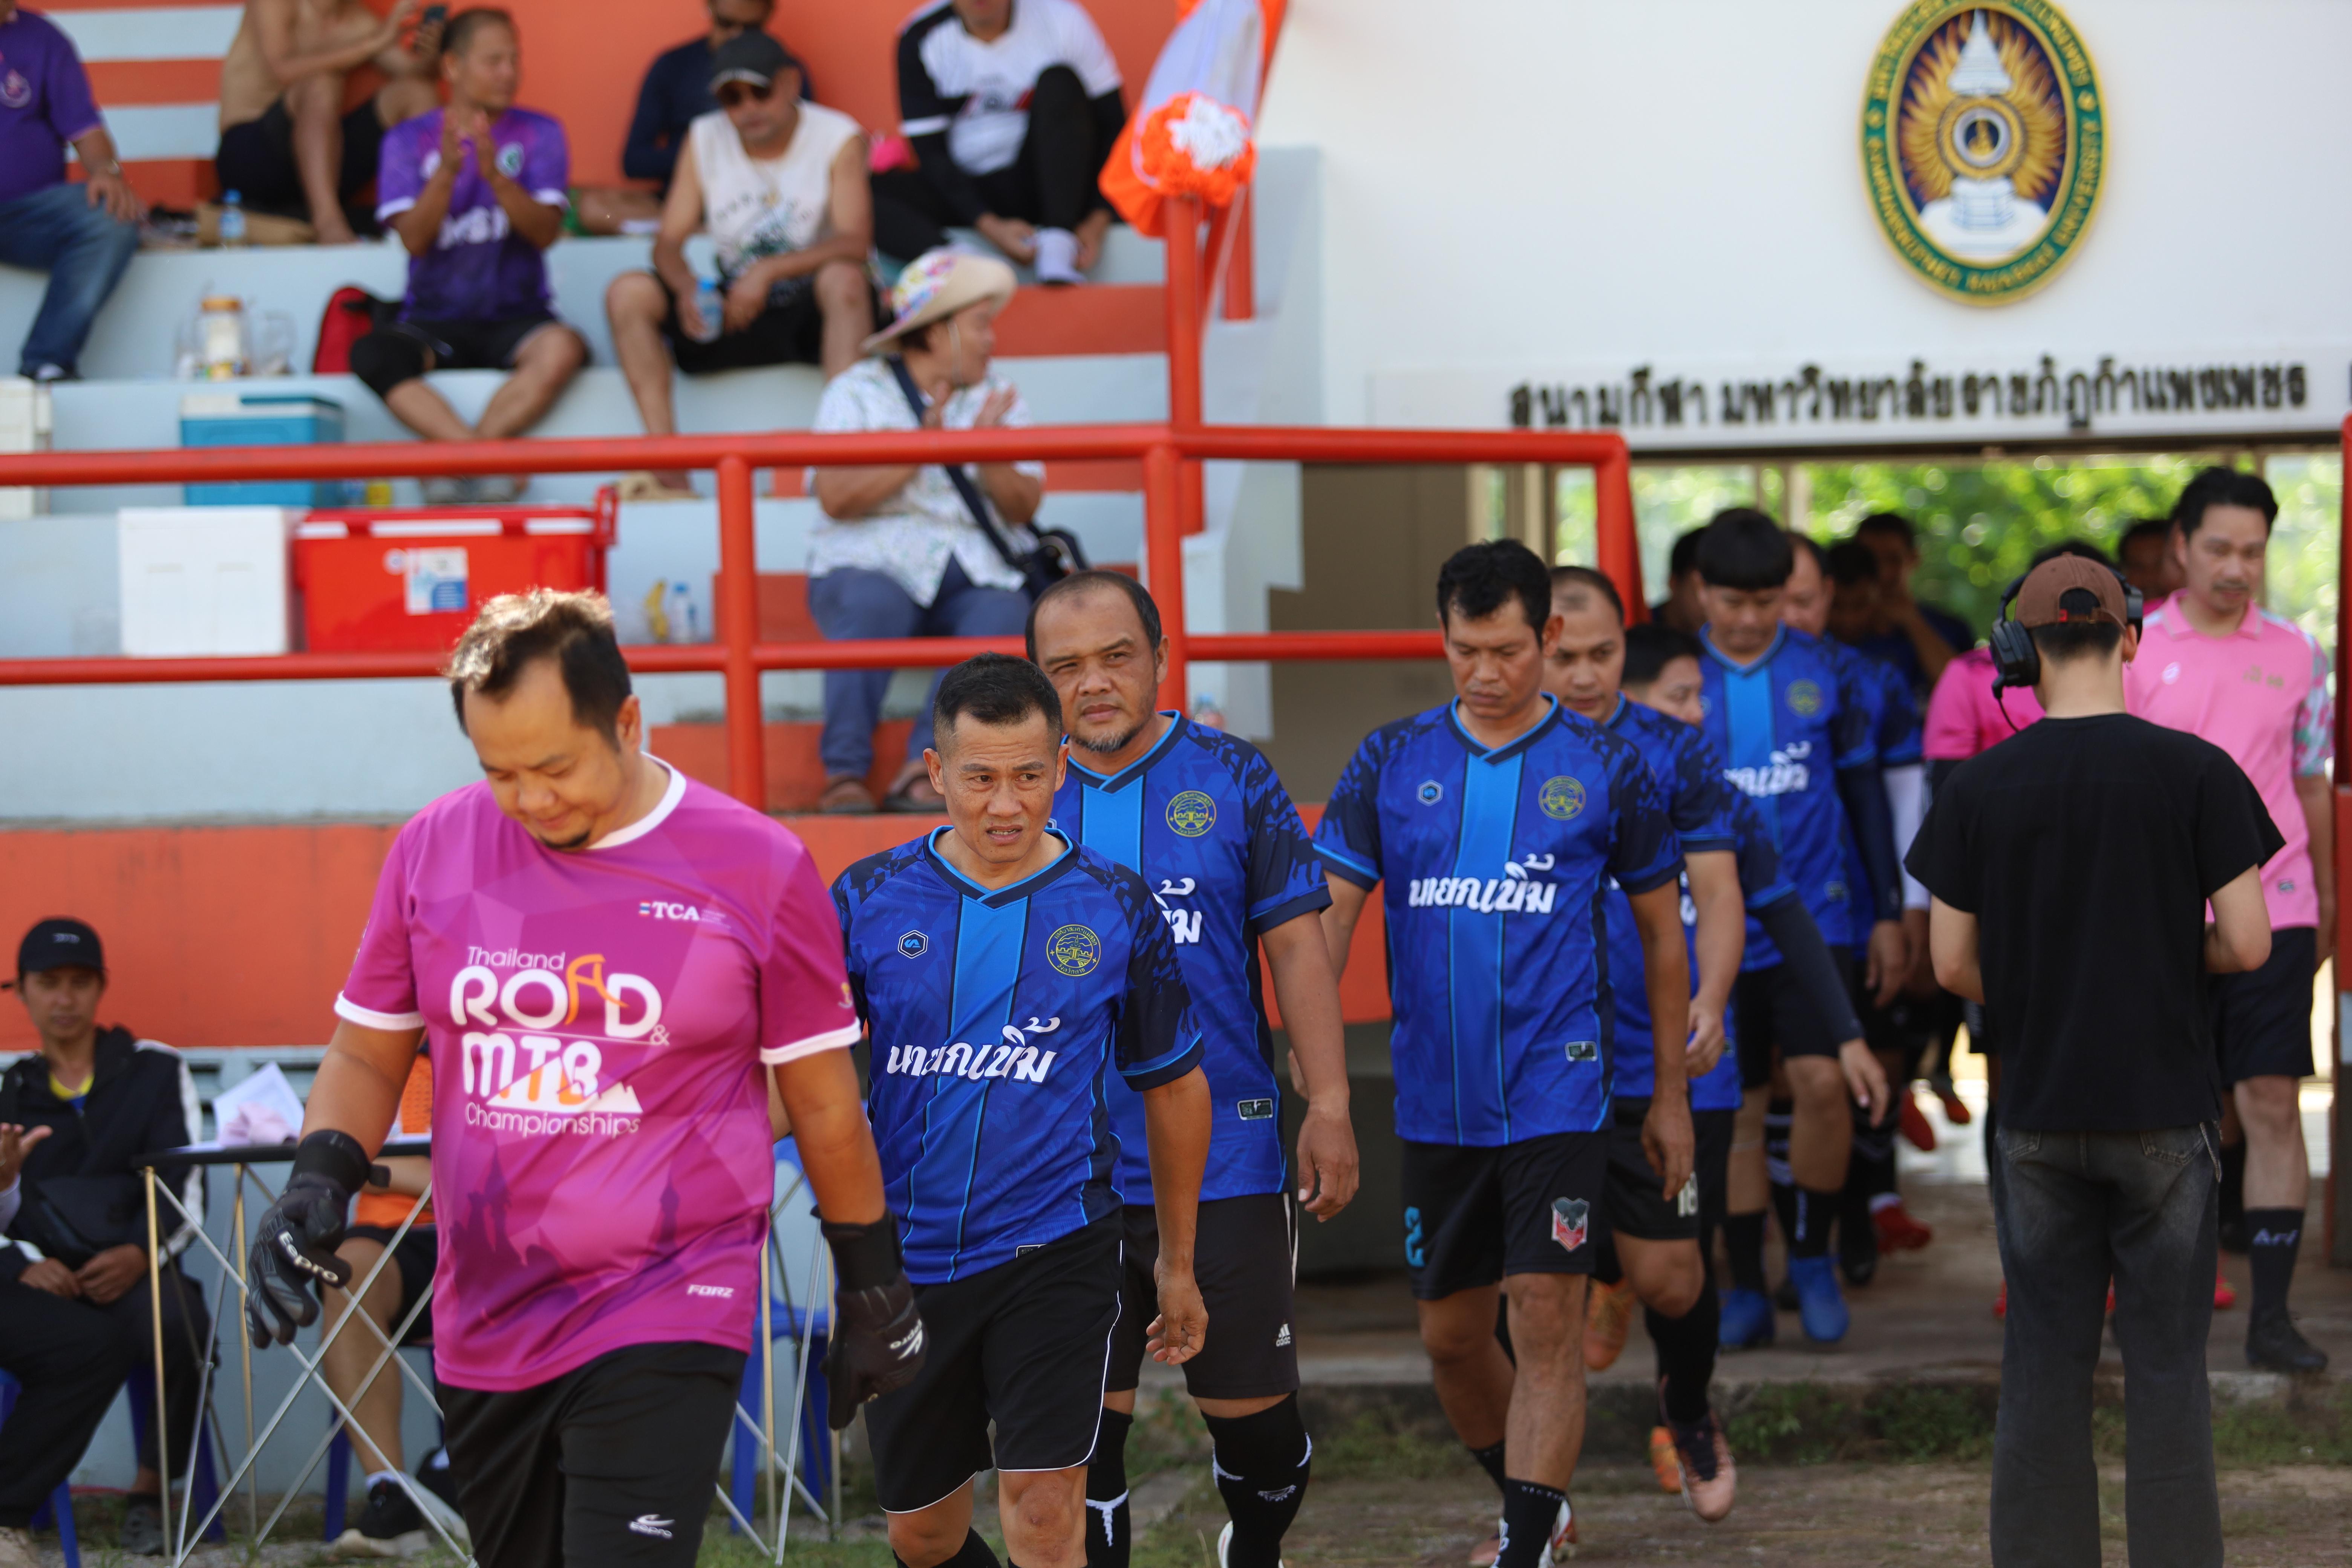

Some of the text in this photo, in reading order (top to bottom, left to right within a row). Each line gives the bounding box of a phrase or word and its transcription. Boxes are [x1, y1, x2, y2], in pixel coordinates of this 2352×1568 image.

[652, 901, 700, 920] TCA
[467, 946, 565, 971] Thailand
[450, 954, 670, 1047] ROAD &
[462, 1032, 602, 1106] MTB
[465, 1102, 642, 1139] Championships
